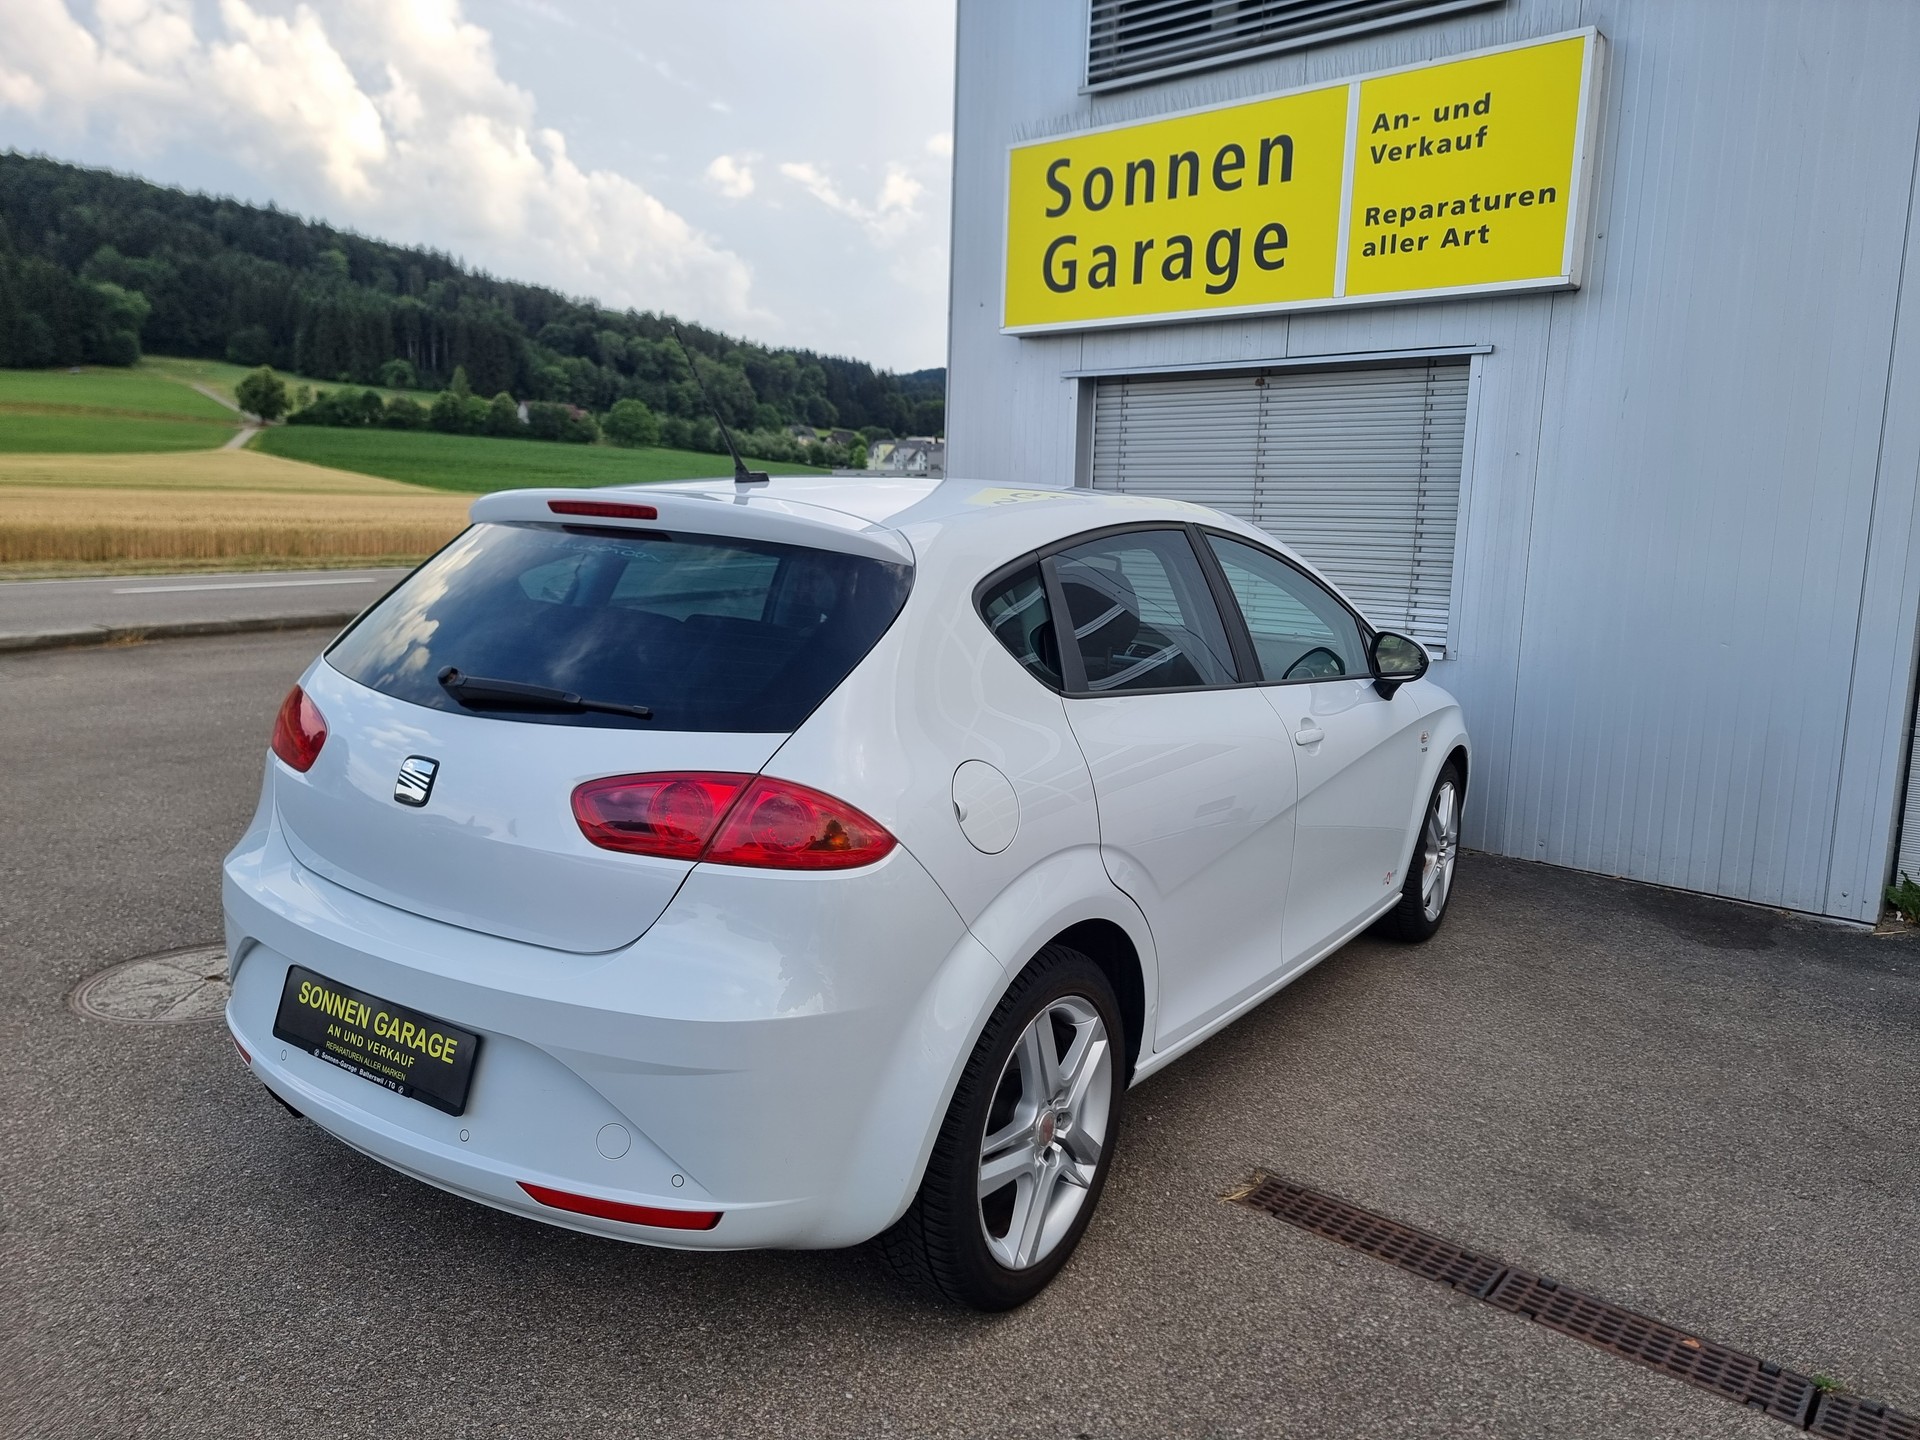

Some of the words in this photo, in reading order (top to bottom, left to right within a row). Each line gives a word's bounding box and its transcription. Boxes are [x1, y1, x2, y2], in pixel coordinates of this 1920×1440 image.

[1371, 113, 1423, 134] An-
[1433, 92, 1491, 123] und
[1370, 125, 1489, 165] Verkauf
[1045, 134, 1294, 218] Sonnen
[1365, 186, 1557, 228] Reparaturen
[1042, 222, 1289, 295] Garage
[1362, 233, 1429, 257] aller
[1440, 224, 1490, 249] Art
[298, 981, 372, 1030] SONNEN
[373, 1011, 459, 1065] GARAGE
[321, 1051, 358, 1073] Sonnen-Garage
[325, 1041, 363, 1063] REPARATUREN
[363, 1057, 382, 1073] ALLER
[381, 1064, 407, 1082] MARKEN
[327, 1023, 342, 1039] AN
[343, 1029, 364, 1047] UND
[367, 1038, 416, 1068] VERKAUF
